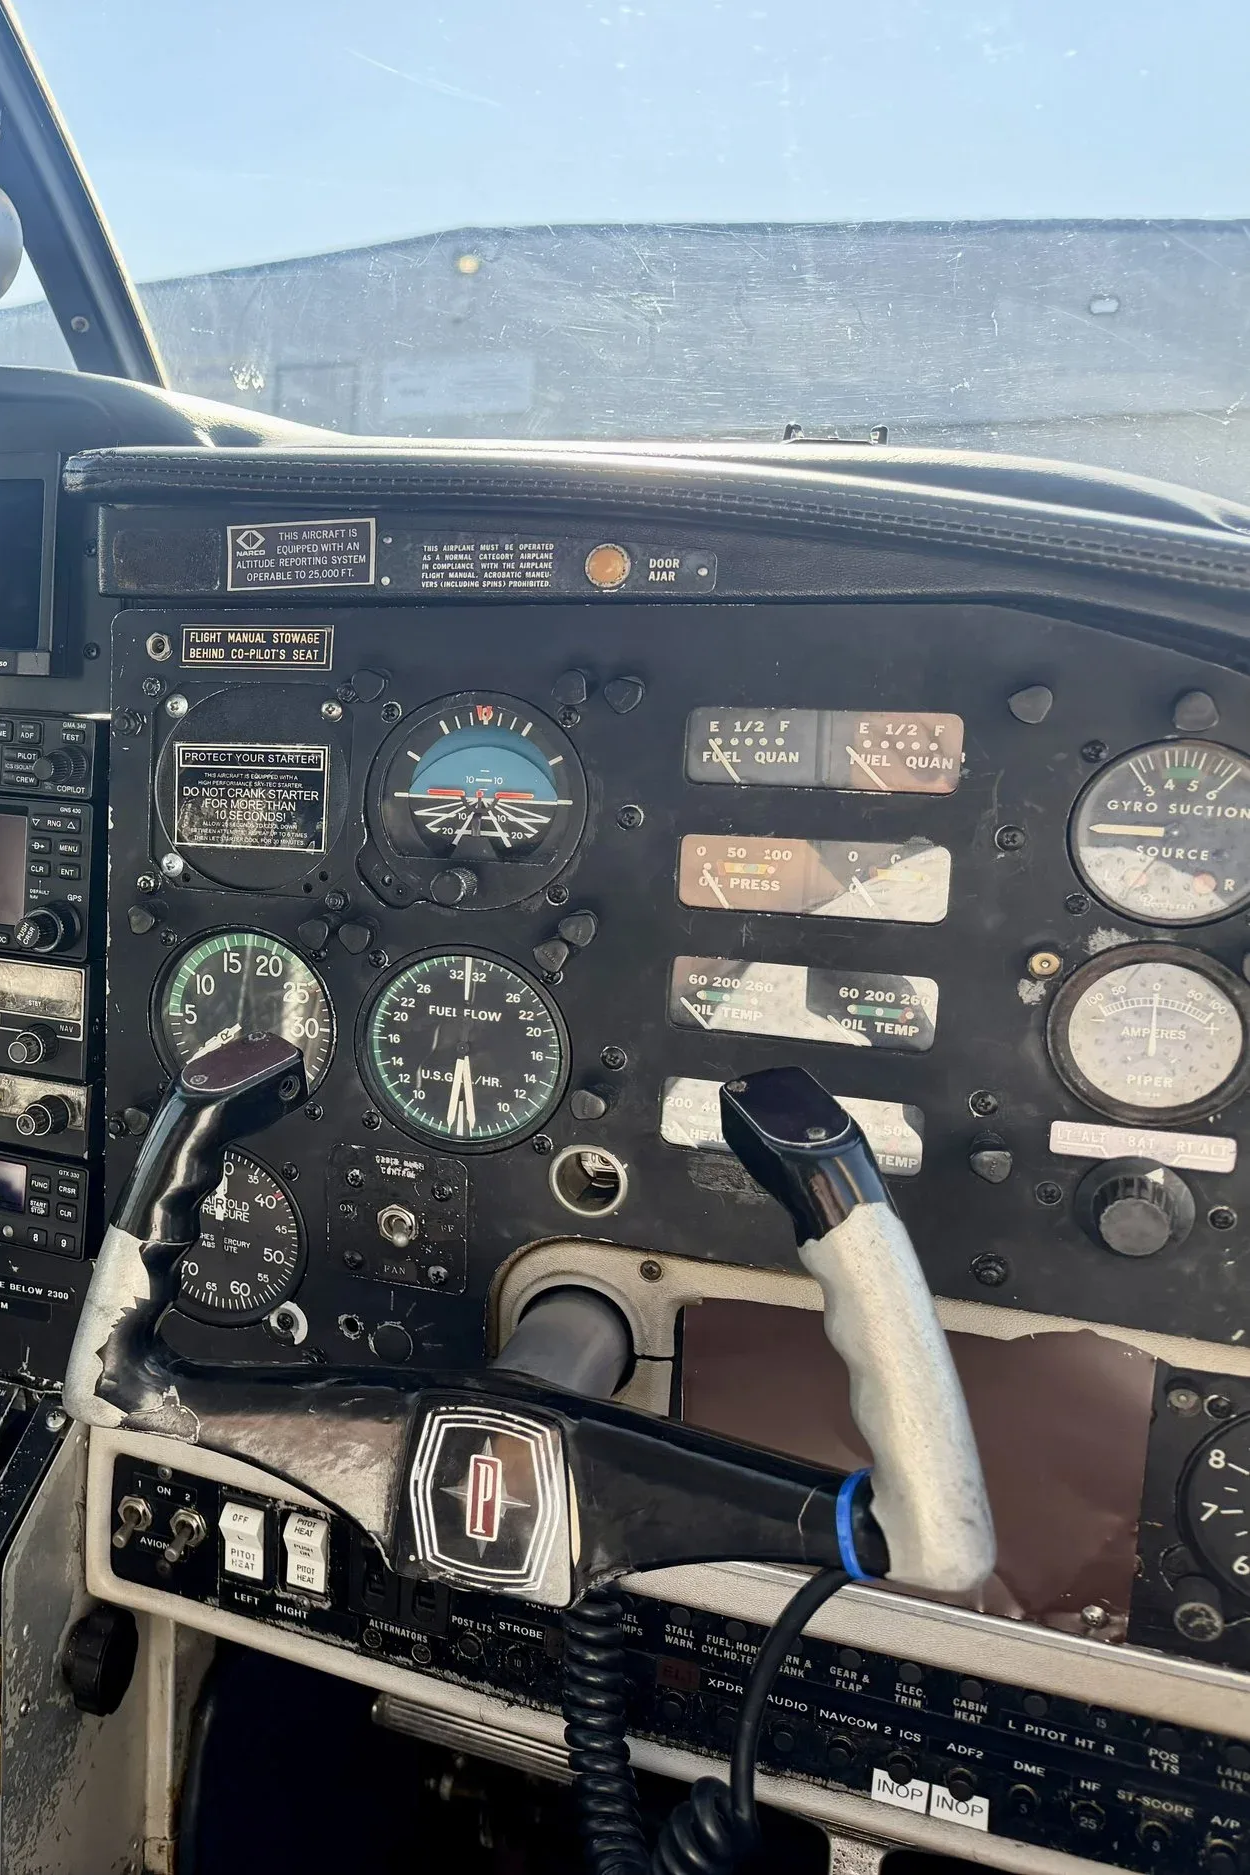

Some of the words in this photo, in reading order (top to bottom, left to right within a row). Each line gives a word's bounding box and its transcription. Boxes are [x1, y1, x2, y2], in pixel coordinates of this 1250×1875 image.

[278, 532, 300, 541] THIS
[302, 529, 345, 540] AIRCRAFT
[348, 528, 357, 537] IS
[277, 543, 318, 554] EQUIPPED
[321, 542, 344, 552] WITH
[346, 541, 359, 550] AN
[236, 558, 275, 569] ALTITUDE
[279, 556, 328, 567] REPORTING
[331, 554, 366, 564] SYSTEM
[479, 553, 515, 561] CATEGORY
[649, 558, 680, 569] DOOR
[432, 562, 474, 570] COMPLIANCE
[246, 571, 292, 582] OPERABLE
[295, 570, 306, 579] TO
[308, 569, 338, 580] 25,000
[341, 568, 354, 577] FT.
[648, 571, 676, 582] AJAR
[440, 581, 480, 589] (INCLUDING
[190, 632, 221, 644] FLIGHT
[227, 633, 267, 644] MANUAL
[272, 633, 320, 644] STOWAGE
[189, 648, 225, 659] BEHIND
[231, 648, 286, 660] CO-PILOT'S
[293, 650, 319, 660] SEAT
[710, 721, 720, 732] E
[734, 721, 765, 733] 1/2
[779, 721, 790, 732] F
[885, 723, 917, 736] 1/2
[20, 731, 34, 740] ADF
[62, 733, 80, 742] TEST
[185, 752, 232, 762] PROTECT
[234, 753, 265, 763] YOUR
[268, 754, 319, 764] STARTER!
[754, 751, 799, 763] QUAN
[905, 756, 954, 770] QUAN
[16, 776, 35, 785] CREW
[56, 785, 86, 795] COPILOT
[183, 787, 199, 797] DO
[202, 787, 225, 798] NOT
[227, 788, 265, 799] CRANK
[269, 789, 319, 801] STARTER
[205, 799, 228, 809] FOR
[231, 799, 263, 810] MORE
[265, 801, 296, 811] THAN
[1107, 799, 1159, 813] GYRO
[1168, 803, 1250, 819] SUCTION
[47, 819, 61, 828] RNG
[215, 810, 226, 819] 10
[229, 811, 286, 823] SECONDS!
[59, 844, 78, 854] MENU
[1136, 845, 1209, 861] SOURCE
[30, 864, 44, 873] CLR
[60, 868, 74, 877] ENT
[730, 878, 781, 891] PRESS
[67, 894, 82, 903] GPS
[223, 953, 242, 973] 15
[256, 955, 283, 977] 20
[450, 970, 464, 980] 32
[472, 972, 486, 982] 32
[196, 975, 215, 995] 10
[839, 987, 860, 999] 60
[864, 990, 896, 1003] 200
[400, 998, 415, 1008] 22
[518, 1010, 534, 1020] 22
[429, 1005, 457, 1017] FUEL
[464, 1009, 502, 1022] FLOW
[59, 1025, 74, 1034] NAV
[291, 1017, 319, 1039] 30
[841, 1018, 867, 1031] OIL
[874, 1021, 920, 1037] TEMP
[1121, 1027, 1187, 1041] AMPERES
[1127, 1075, 1173, 1089] PIPER
[31, 1179, 48, 1190] FUNC
[58, 1184, 76, 1195] CRSR
[254, 1195, 277, 1209] 40
[263, 1248, 285, 1264] 50
[384, 1264, 406, 1275] FAN
[9, 1282, 43, 1297] BELOW
[47, 1290, 69, 1300] 2300
[230, 1282, 250, 1297] 60
[157, 1485, 171, 1497] ON
[231, 1513, 249, 1524] OFF
[230, 1547, 256, 1561] PITOT
[231, 1558, 255, 1572] HEAT
[234, 1592, 260, 1606] LEFT
[275, 1603, 309, 1620] RIGHT
[369, 1618, 428, 1644] ALTERNATORS
[499, 1621, 544, 1640] STROBE
[665, 1624, 695, 1639] STALL
[664, 1634, 697, 1651] WARN.
[829, 1665, 858, 1681] GEAR
[707, 1677, 744, 1695] XPDR
[835, 1678, 863, 1693] FLAP
[766, 1694, 808, 1713] AUDIO
[953, 1697, 989, 1715] CABIN
[819, 1708, 878, 1731] NAVCOM
[884, 1726, 892, 1735] 2
[954, 1710, 983, 1725] HEAT
[1024, 1723, 1068, 1744] PITOT
[946, 1742, 984, 1760] ADF2
[1013, 1759, 1046, 1778] DME
[877, 1777, 924, 1801] INOP
[936, 1793, 984, 1818] INOP
[1210, 1815, 1241, 1830] A/P
